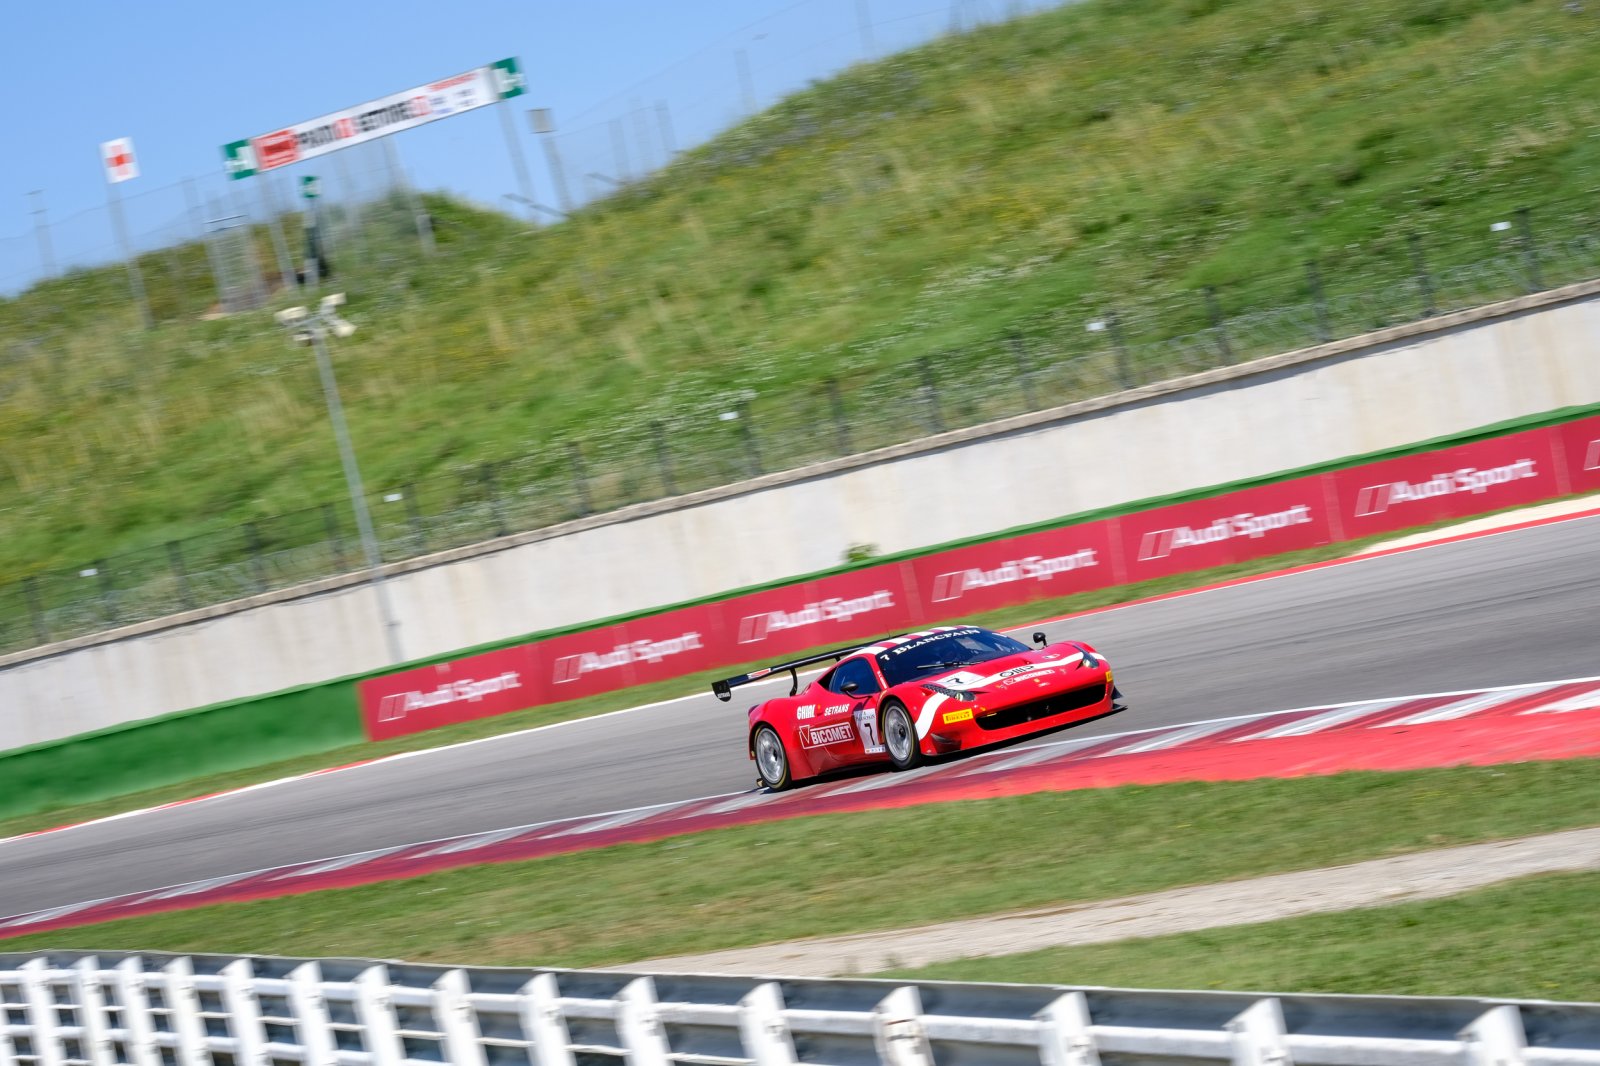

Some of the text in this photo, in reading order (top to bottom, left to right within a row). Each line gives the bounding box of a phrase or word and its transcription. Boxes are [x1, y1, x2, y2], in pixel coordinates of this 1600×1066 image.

[1388, 458, 1537, 505] Audi Sport
[1170, 504, 1312, 549] Audi Sport
[962, 548, 1098, 590] Audi Sport
[765, 590, 895, 633] Audi Sport
[578, 632, 703, 673] Audi Sport
[892, 629, 981, 655] BLANCPAIN
[403, 671, 521, 711] Audi Sport
[824, 703, 850, 716] SETRANS
[810, 725, 852, 745] BICOMET
[864, 722, 876, 746] 7
[945, 711, 970, 722] PIRELLI
